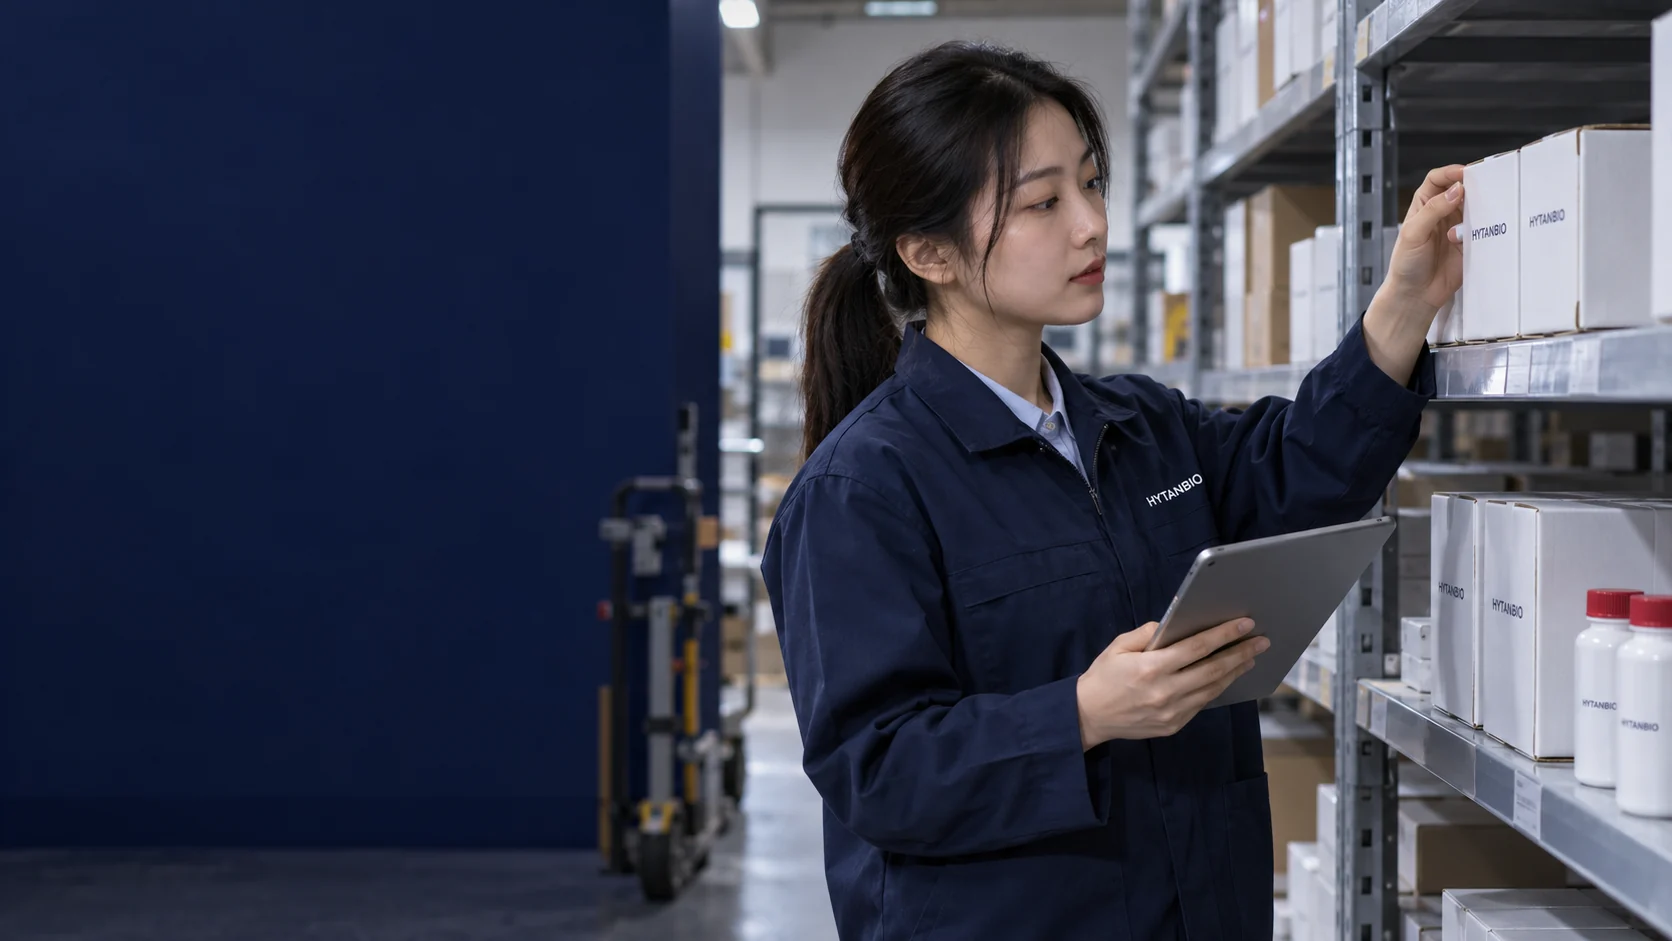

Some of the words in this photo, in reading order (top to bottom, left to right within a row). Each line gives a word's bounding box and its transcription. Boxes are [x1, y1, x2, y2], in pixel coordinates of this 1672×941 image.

[1529, 209, 1565, 228] HYTANBIO
[1472, 223, 1507, 241] HYTANBIO
[1146, 474, 1203, 507] HYTANBIO
[1438, 582, 1464, 600] HYTANBIO
[1492, 598, 1523, 618] HYTANBIO
